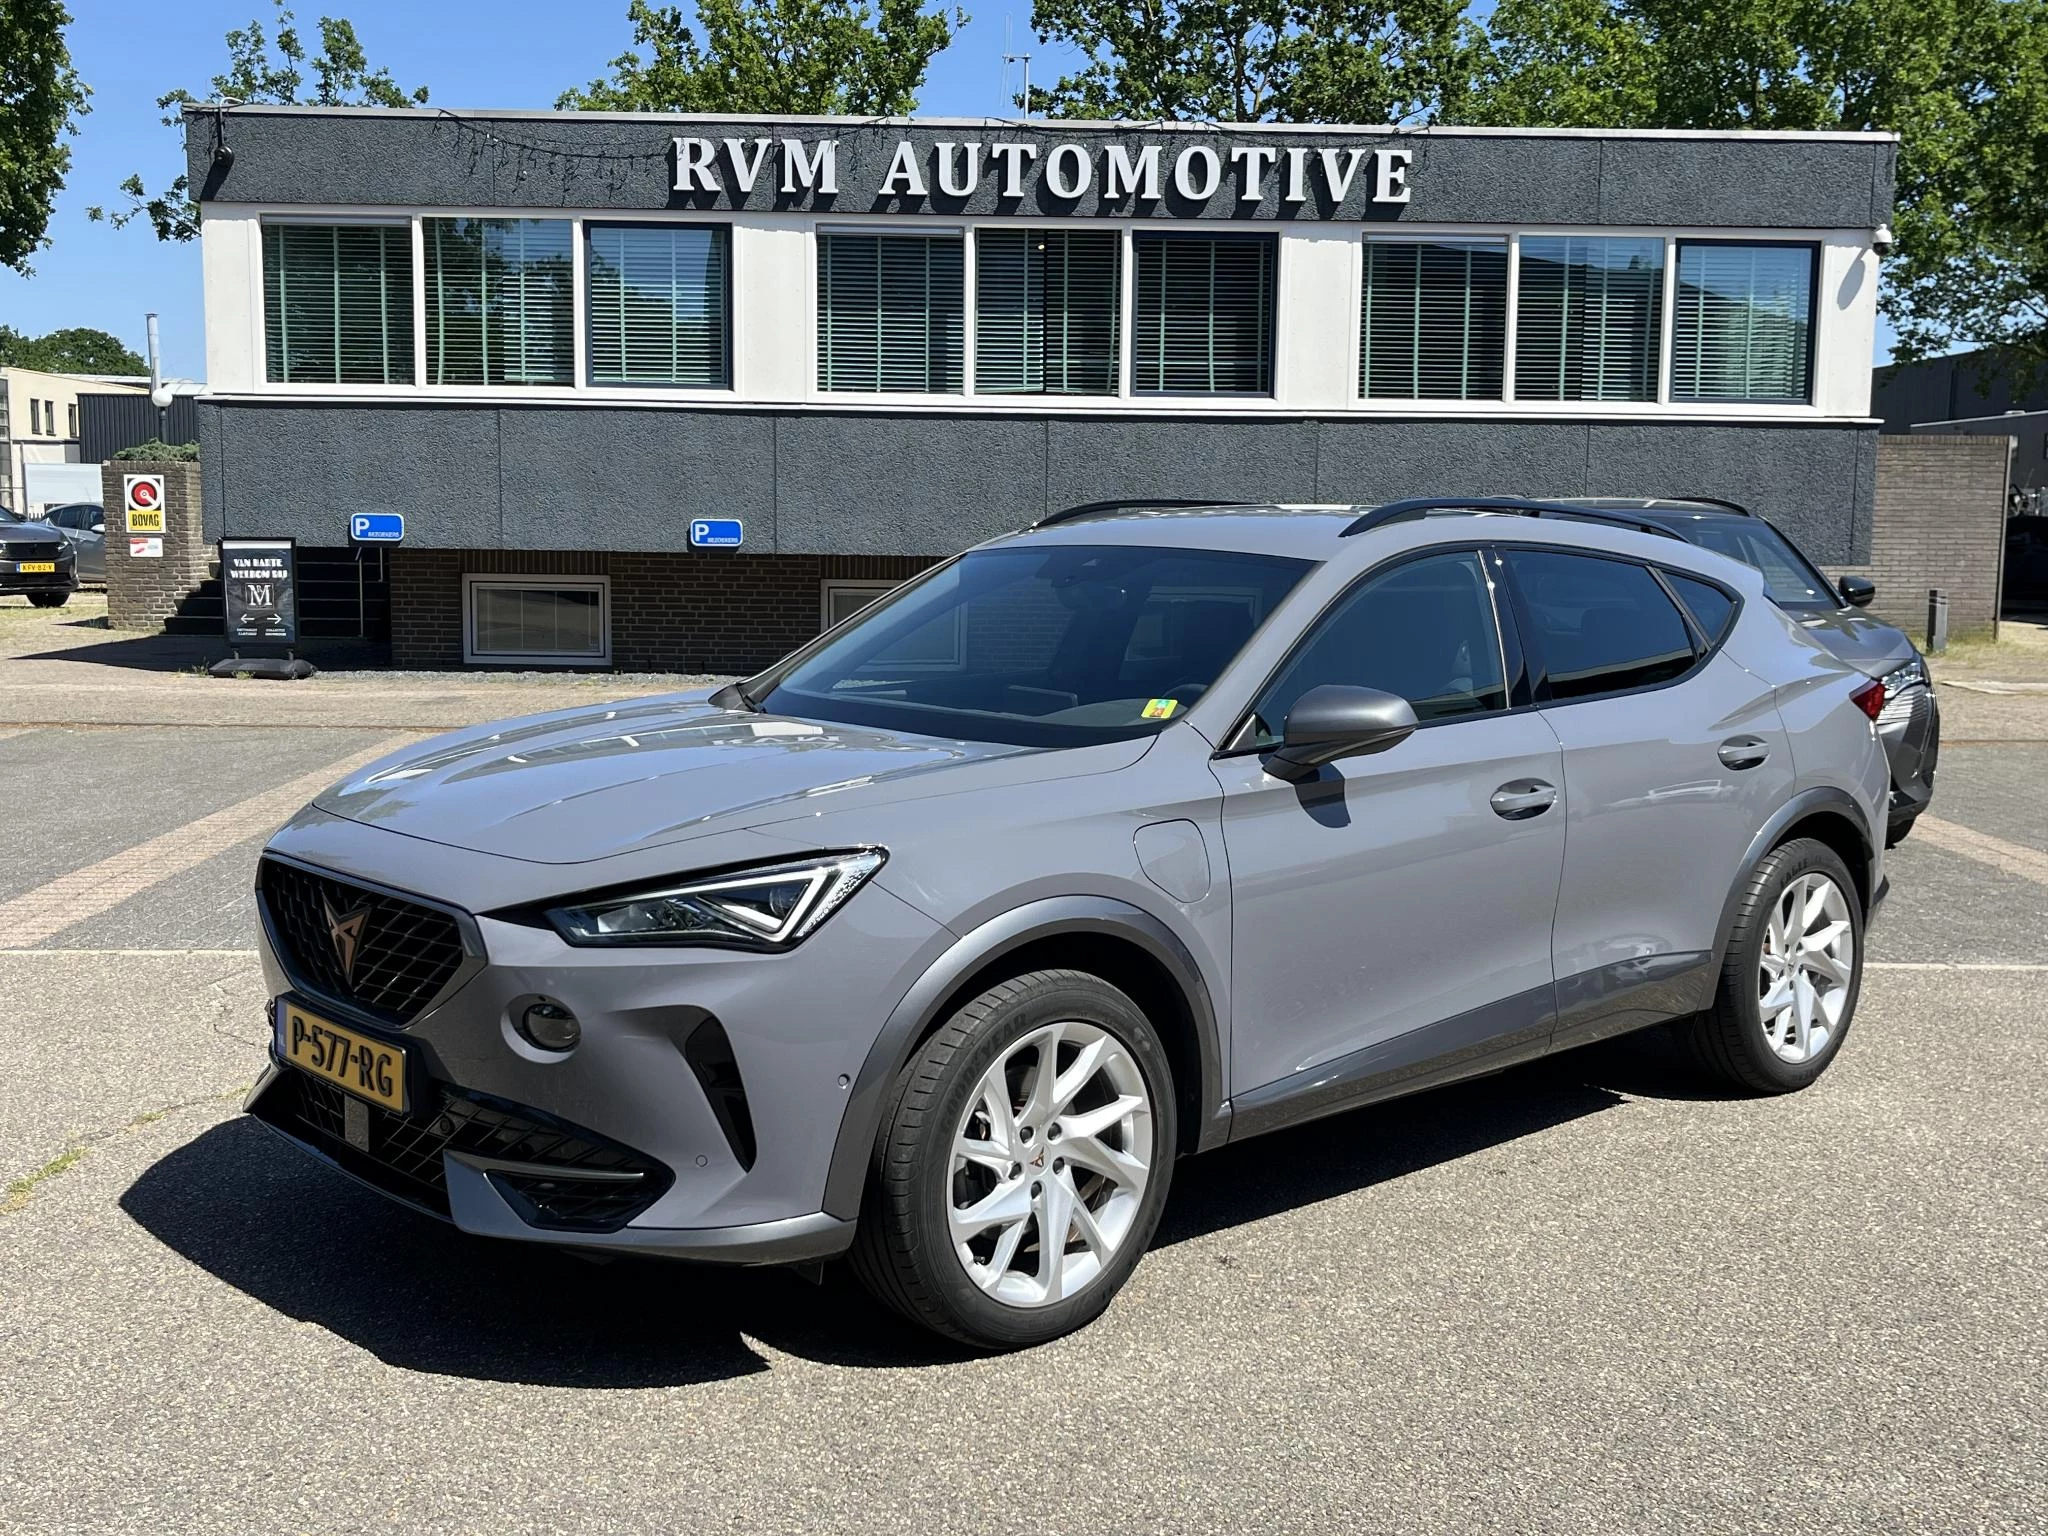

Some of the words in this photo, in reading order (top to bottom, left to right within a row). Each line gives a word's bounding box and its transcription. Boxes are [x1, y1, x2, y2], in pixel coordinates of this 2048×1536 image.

[672, 136, 839, 195] RVM
[878, 141, 1414, 204] AUTOMOTIVE
[132, 514, 160, 527] BOVAG
[355, 518, 370, 536] P
[694, 523, 710, 542] P
[233, 558, 251, 567] VAN
[292, 1015, 393, 1098] P-577-RG
